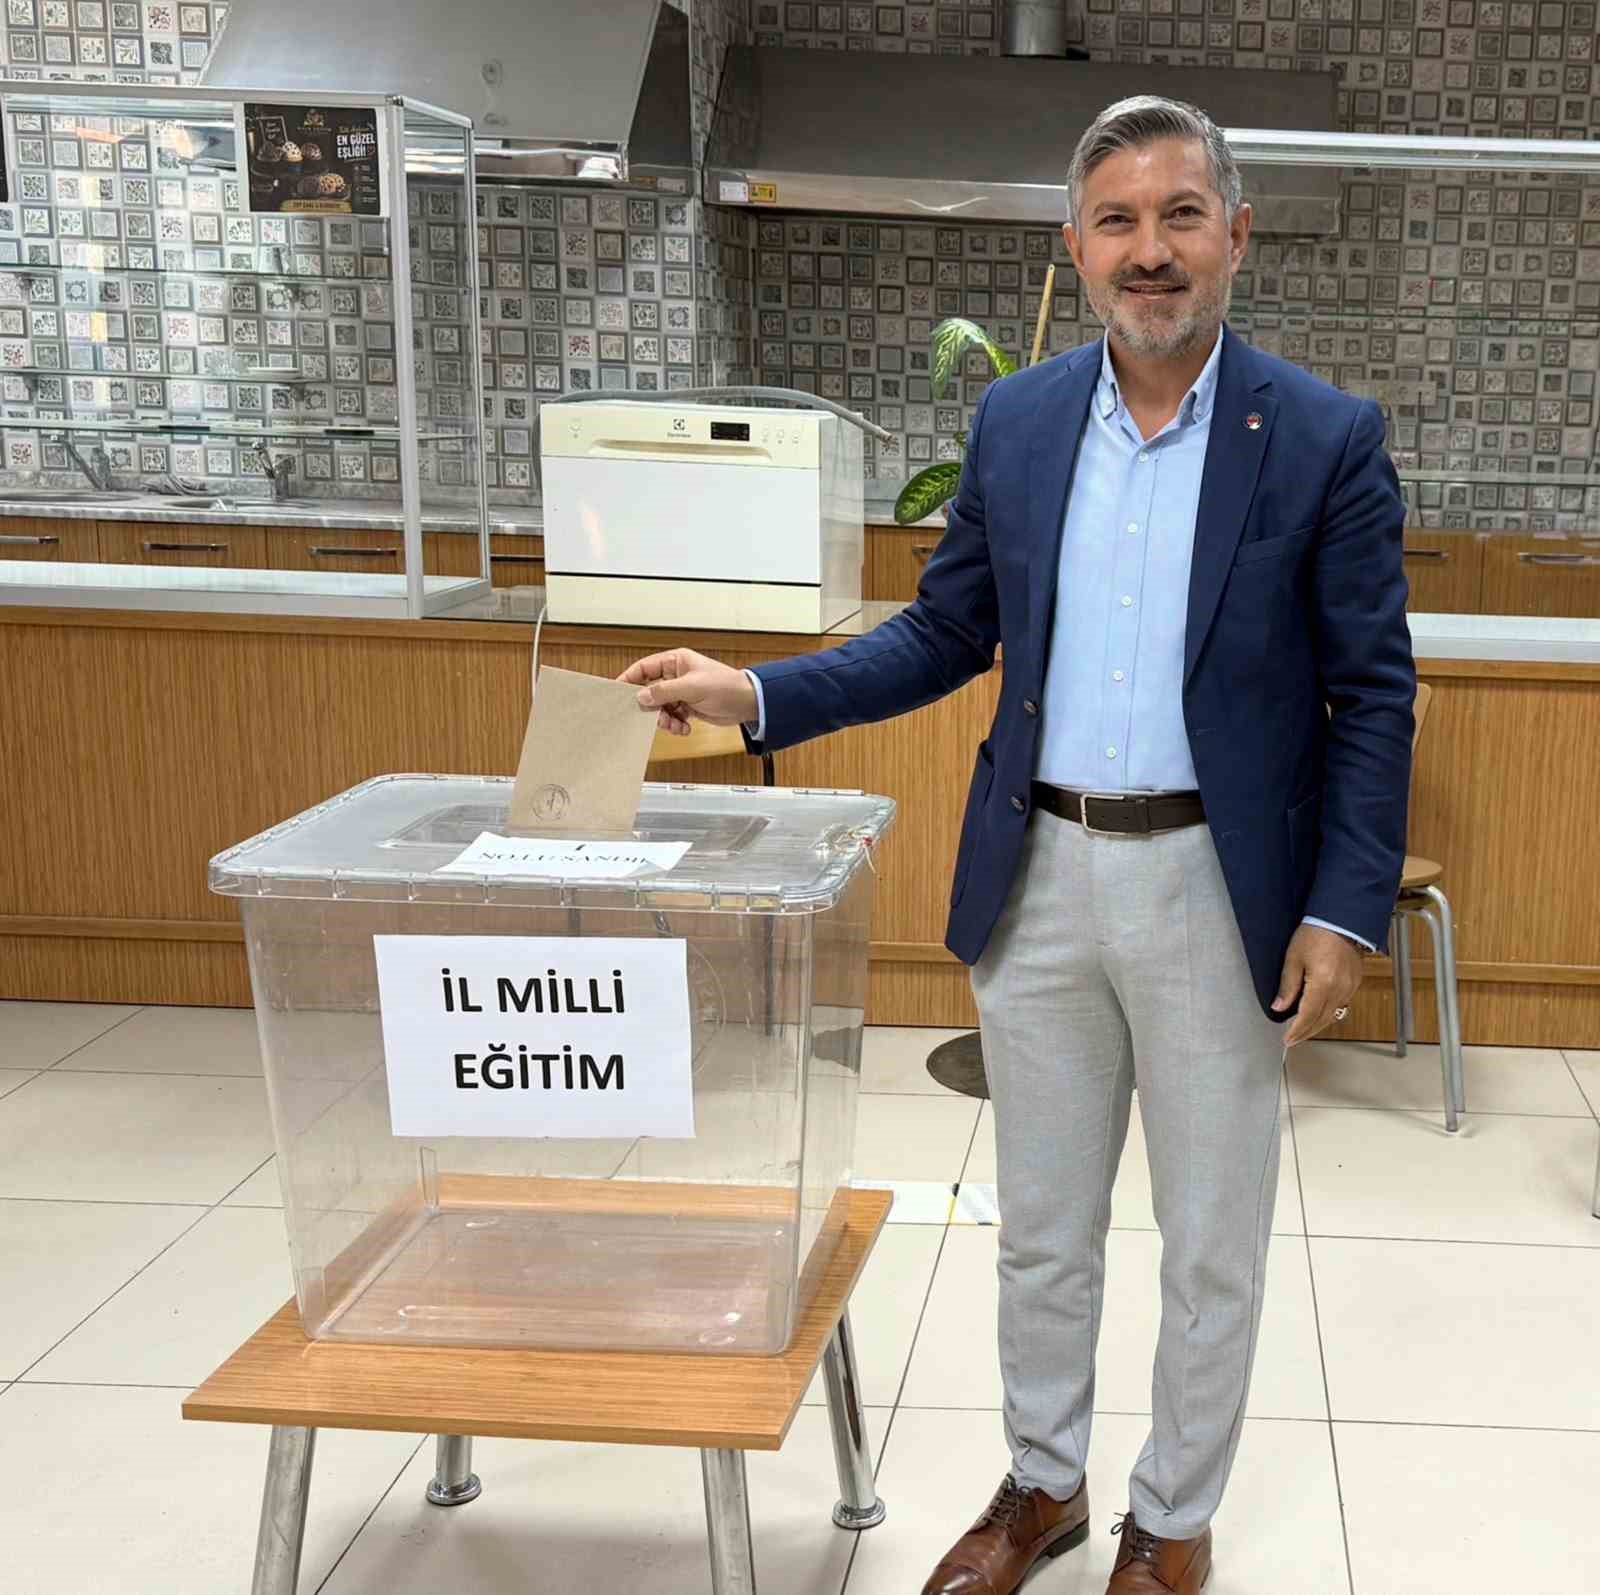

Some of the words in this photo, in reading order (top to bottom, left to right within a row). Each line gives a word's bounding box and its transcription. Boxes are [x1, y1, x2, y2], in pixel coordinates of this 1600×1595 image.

[336, 134, 348, 146] EN
[350, 131, 376, 145] GÜZEL
[441, 967, 483, 1012] İL
[496, 968, 626, 1013] MİLLİ
[454, 1043, 625, 1090] EĞİTİM
